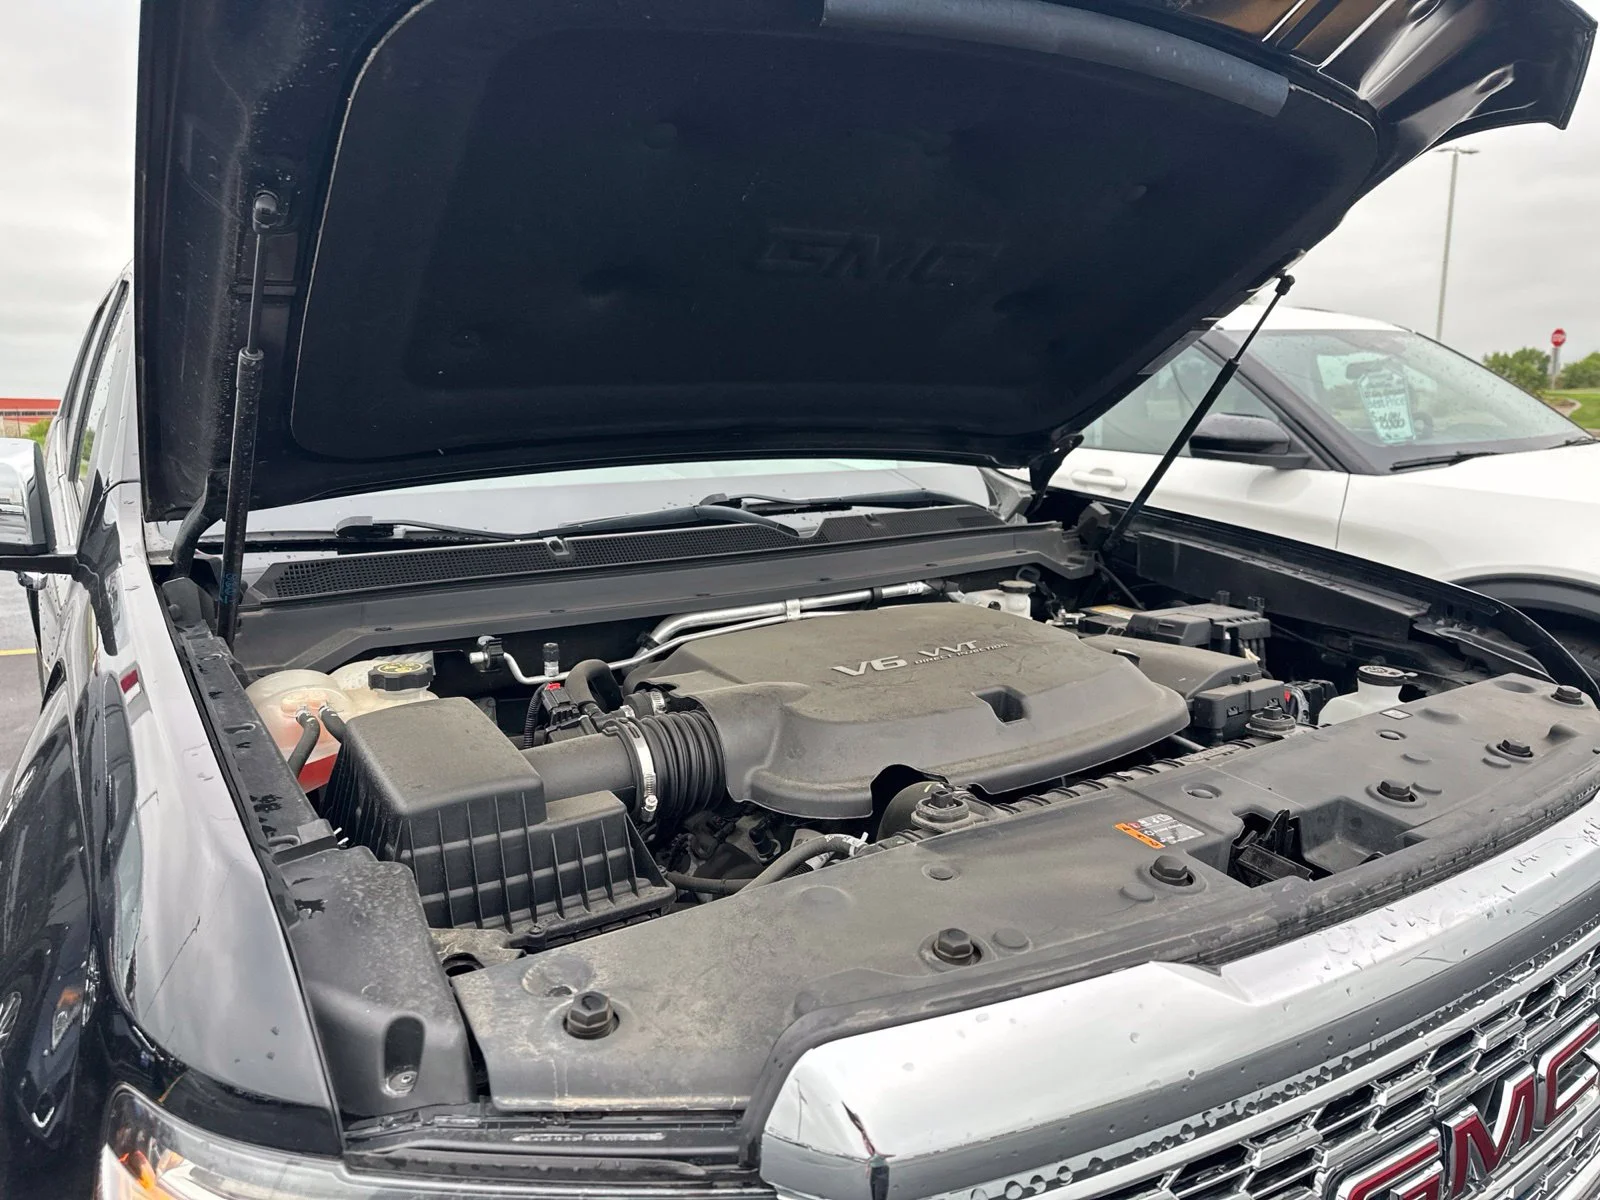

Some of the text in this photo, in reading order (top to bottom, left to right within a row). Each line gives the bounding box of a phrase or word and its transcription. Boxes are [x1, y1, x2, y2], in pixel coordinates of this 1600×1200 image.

[831, 640, 977, 677] V6 VVT
[914, 642, 1010, 665] DIRECT INJECTION
